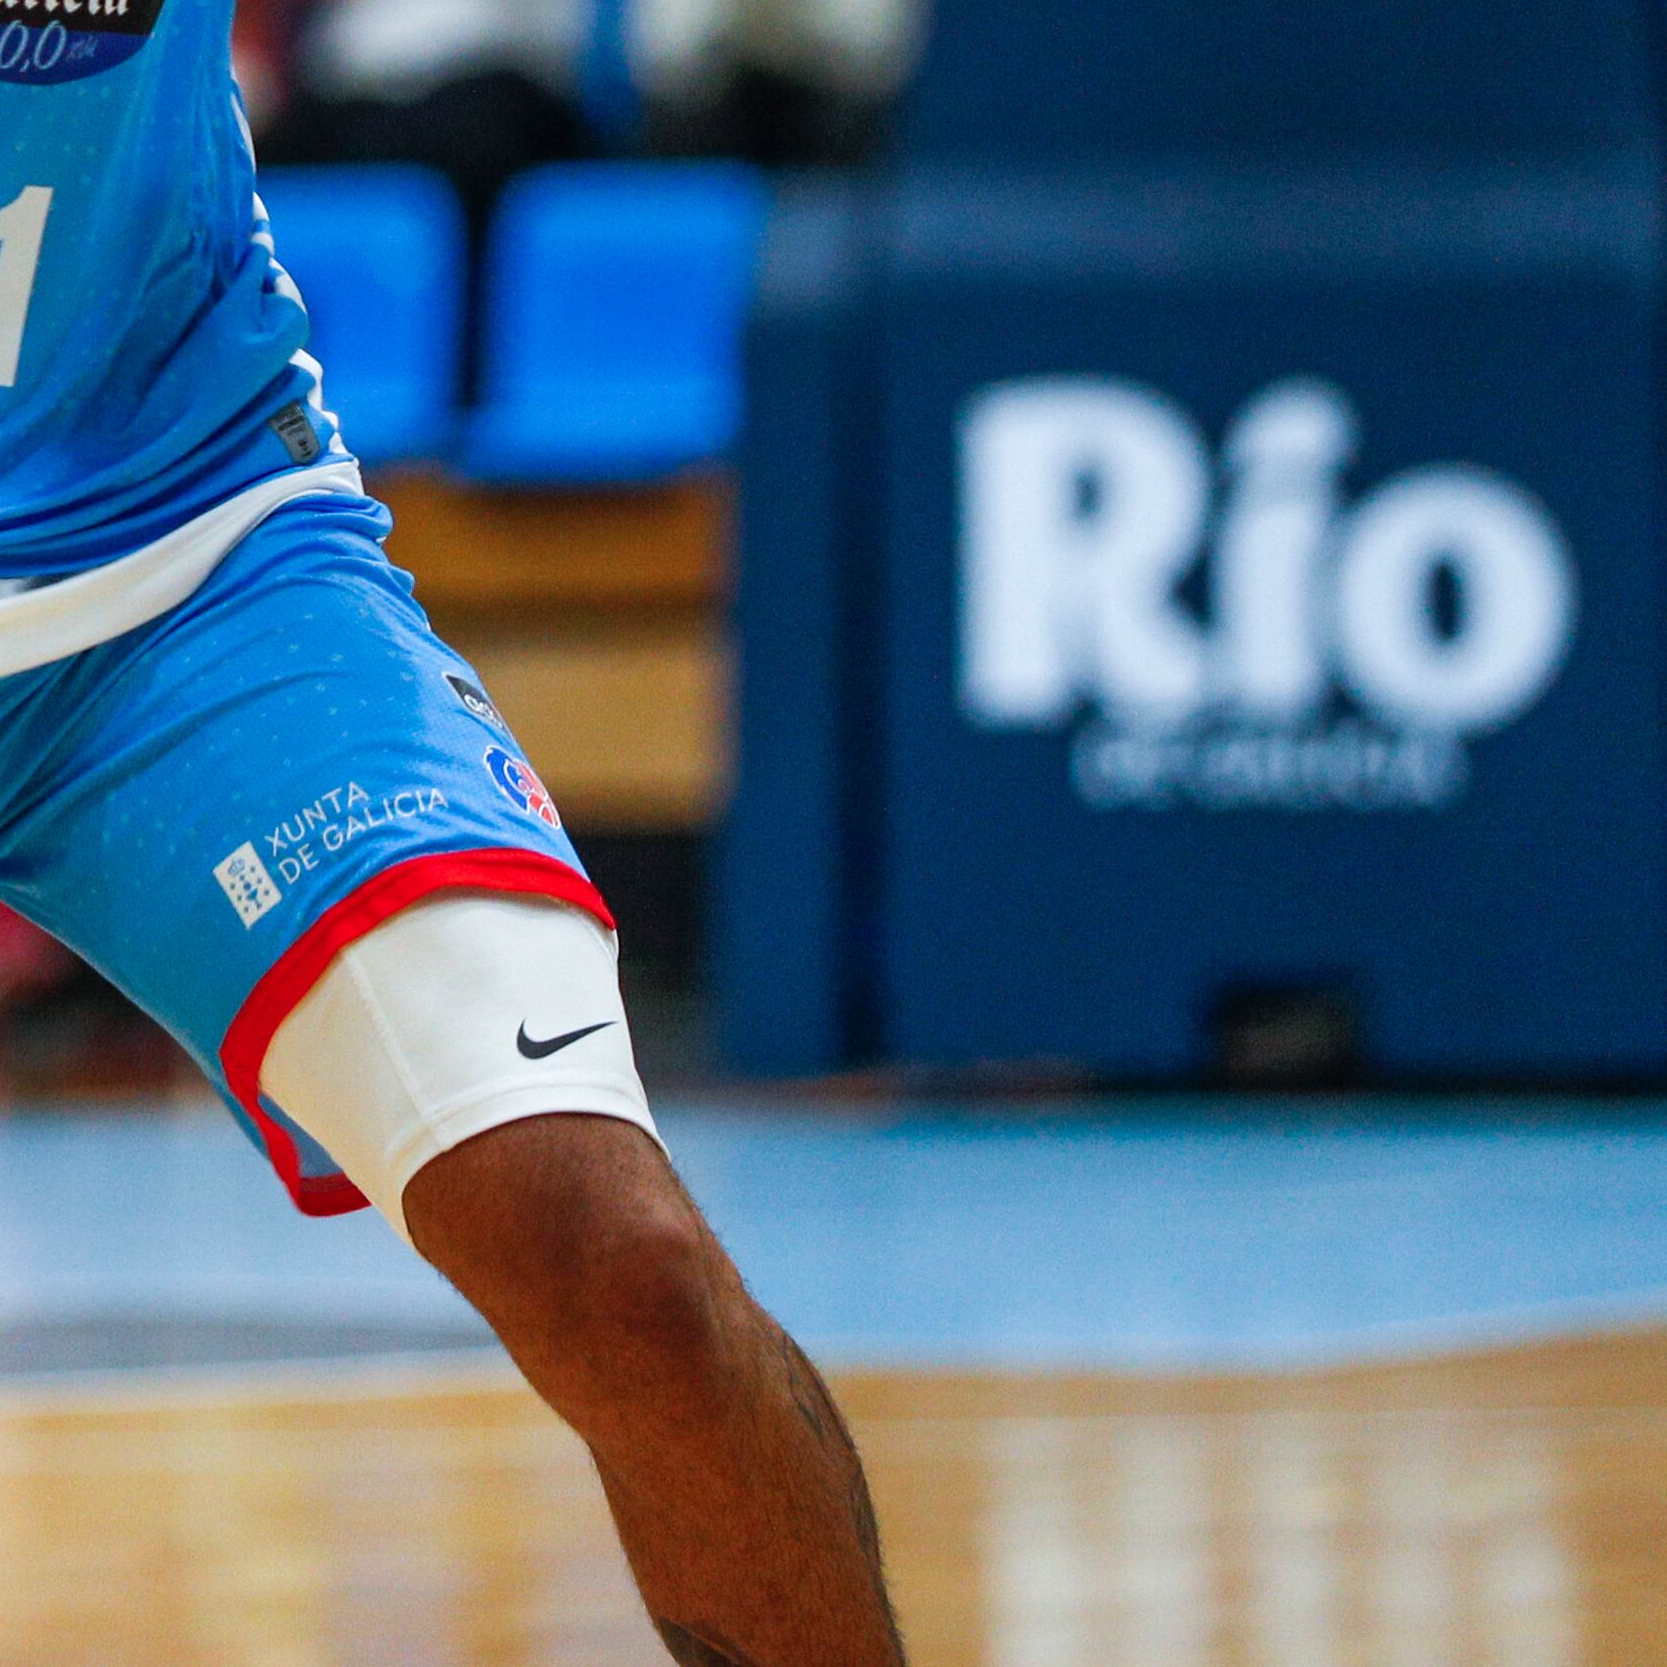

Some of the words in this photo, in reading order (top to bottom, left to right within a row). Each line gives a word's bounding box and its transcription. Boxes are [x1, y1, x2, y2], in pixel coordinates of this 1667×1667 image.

[264, 780, 370, 858] XUNTA
[277, 843, 321, 886] DE
[321, 788, 450, 852] GALICIA
